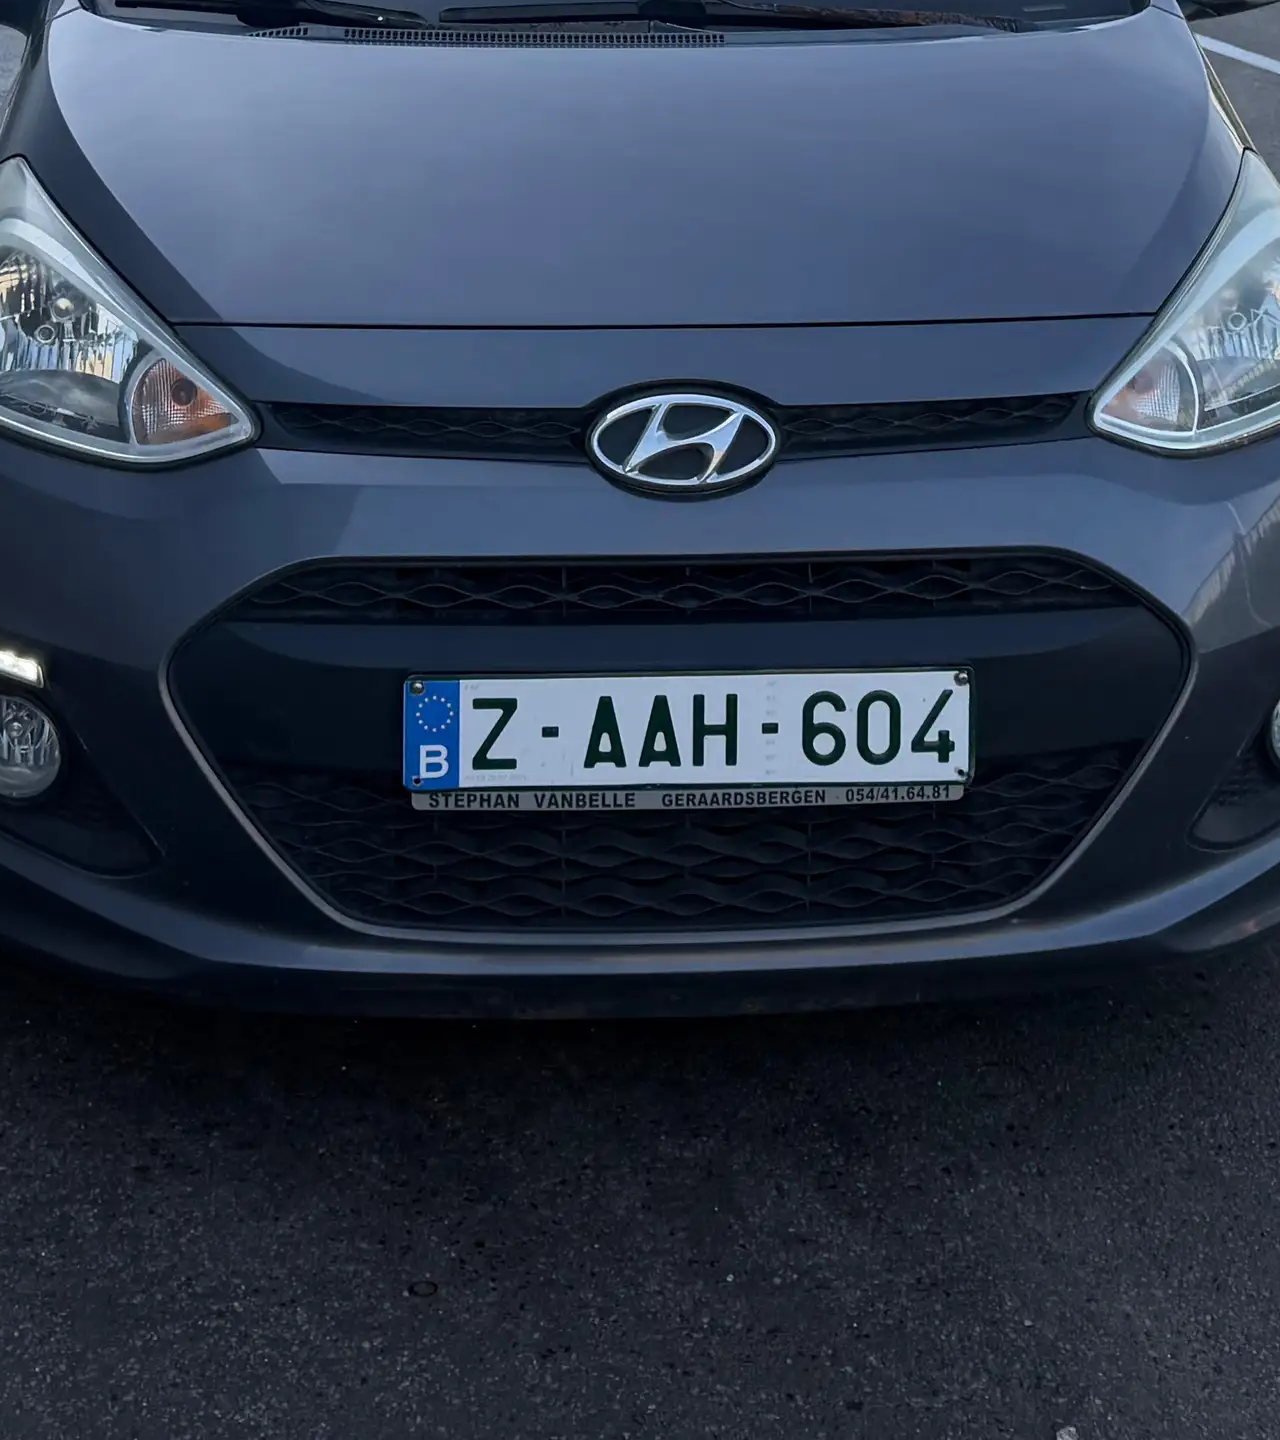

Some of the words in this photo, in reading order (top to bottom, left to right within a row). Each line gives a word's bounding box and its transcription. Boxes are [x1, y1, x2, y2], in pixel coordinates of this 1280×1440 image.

[420, 744, 449, 779] B
[428, 792, 520, 809] STEPHAN
[534, 791, 636, 808] VANBELLE
[662, 788, 826, 808] GERAARDSBERGEN
[846, 784, 951, 803] 054/41.64.81
